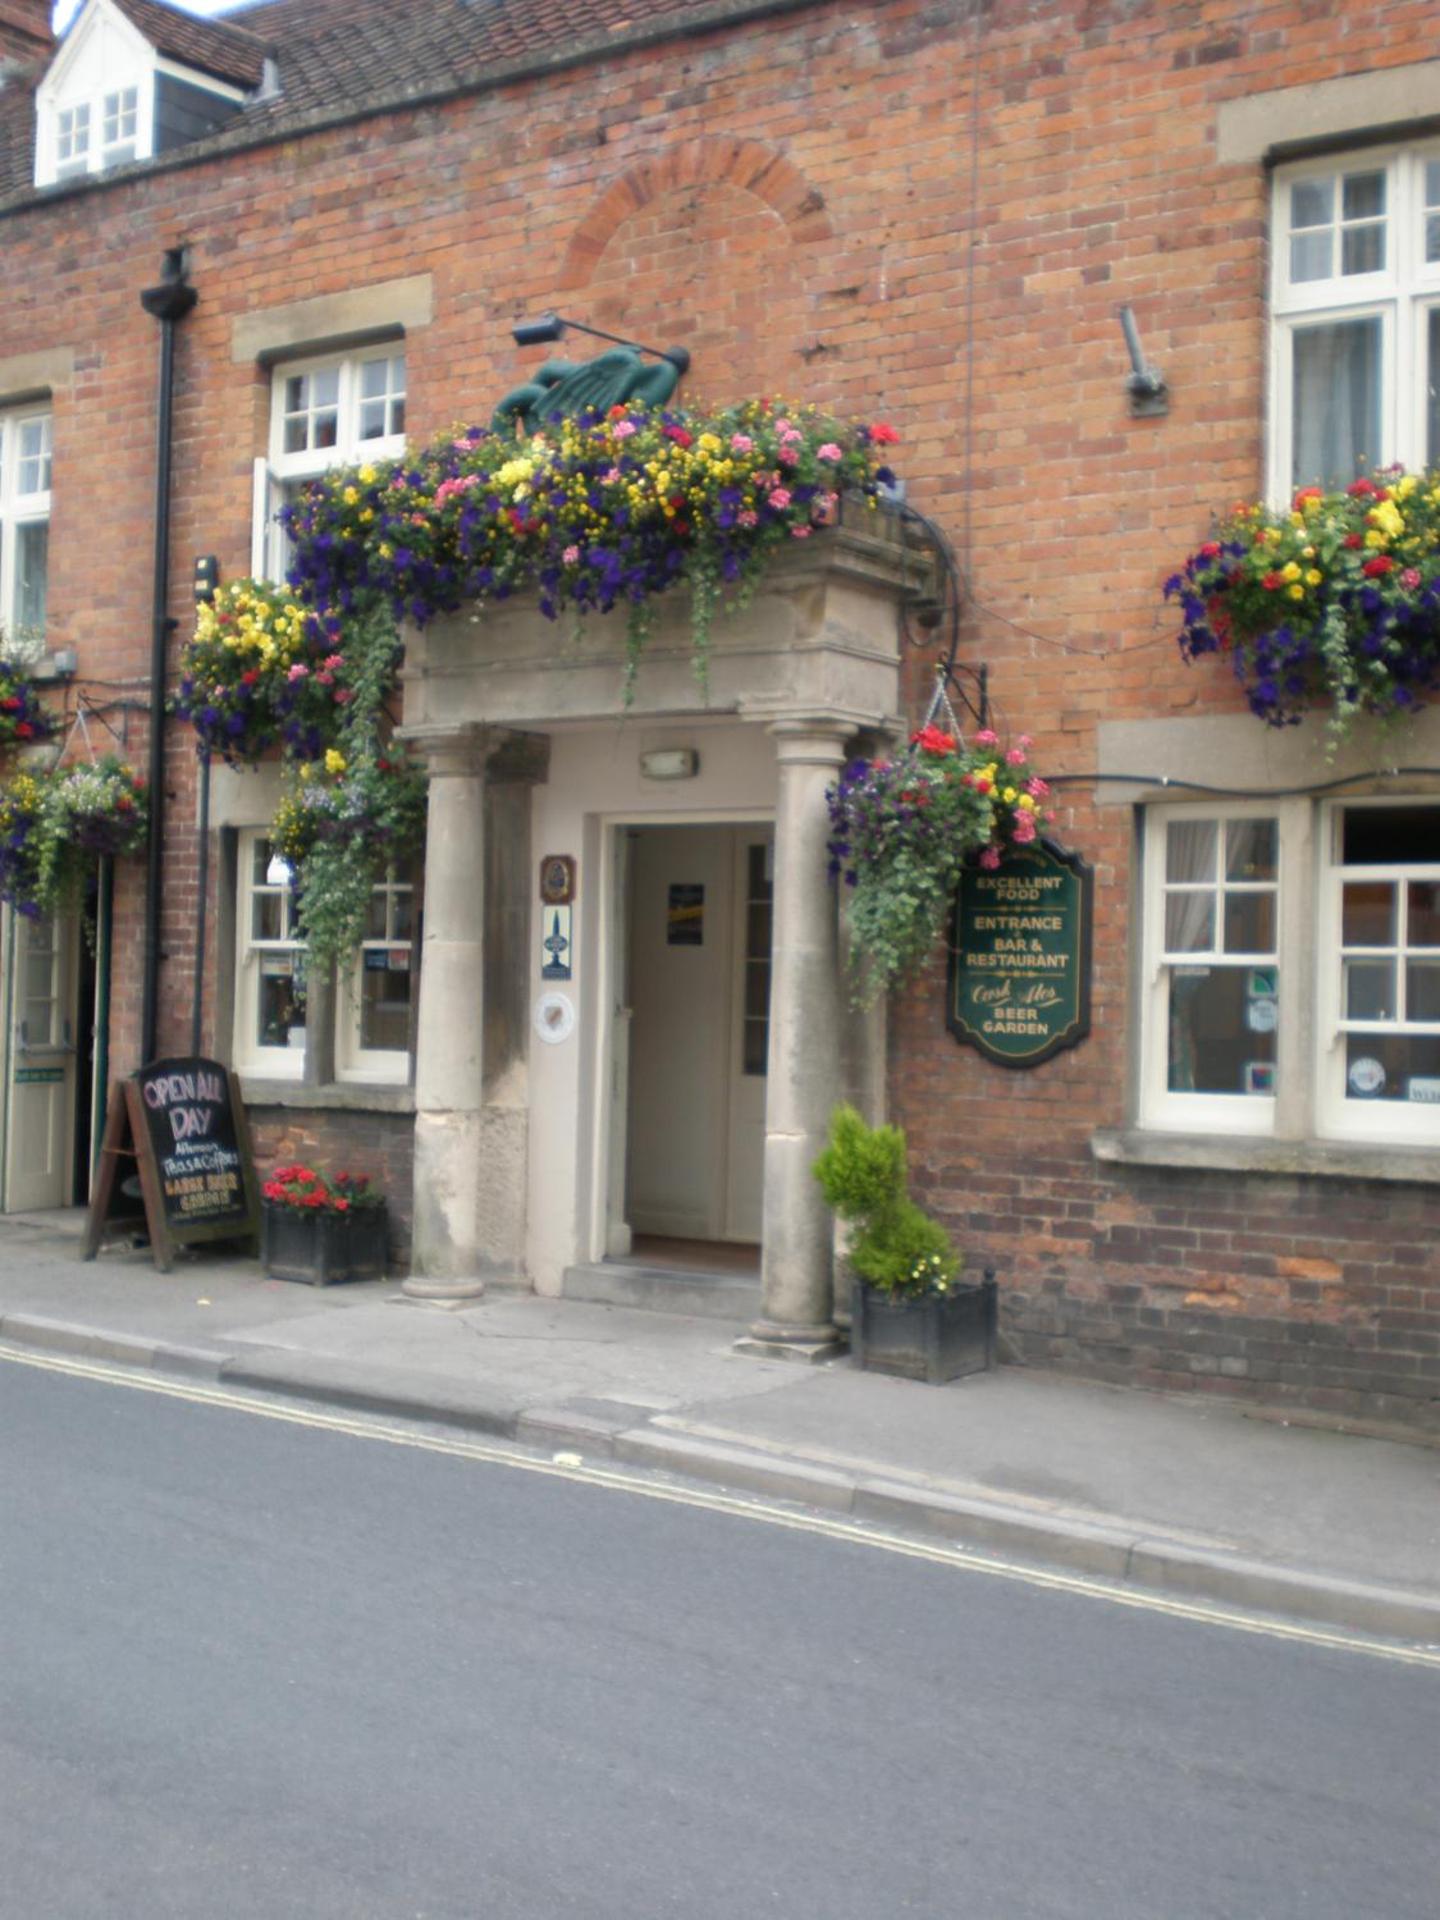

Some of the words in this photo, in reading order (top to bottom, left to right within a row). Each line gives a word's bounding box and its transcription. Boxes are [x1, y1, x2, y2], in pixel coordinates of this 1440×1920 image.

[976, 876, 1063, 889] EXCELLENT
[996, 888, 1040, 900] FOOD
[974, 916, 1062, 930] ENTRANCE
[994, 938, 1027, 951] BAR
[1031, 938, 1043, 952] &
[966, 953, 1069, 968] RESTAURANT
[994, 1008, 1038, 1020] BEER
[983, 1021, 1048, 1035] GARDEN
[143, 1073, 195, 1109] OPEN
[197, 1069, 223, 1103] ALL
[168, 1106, 212, 1141] DAY
